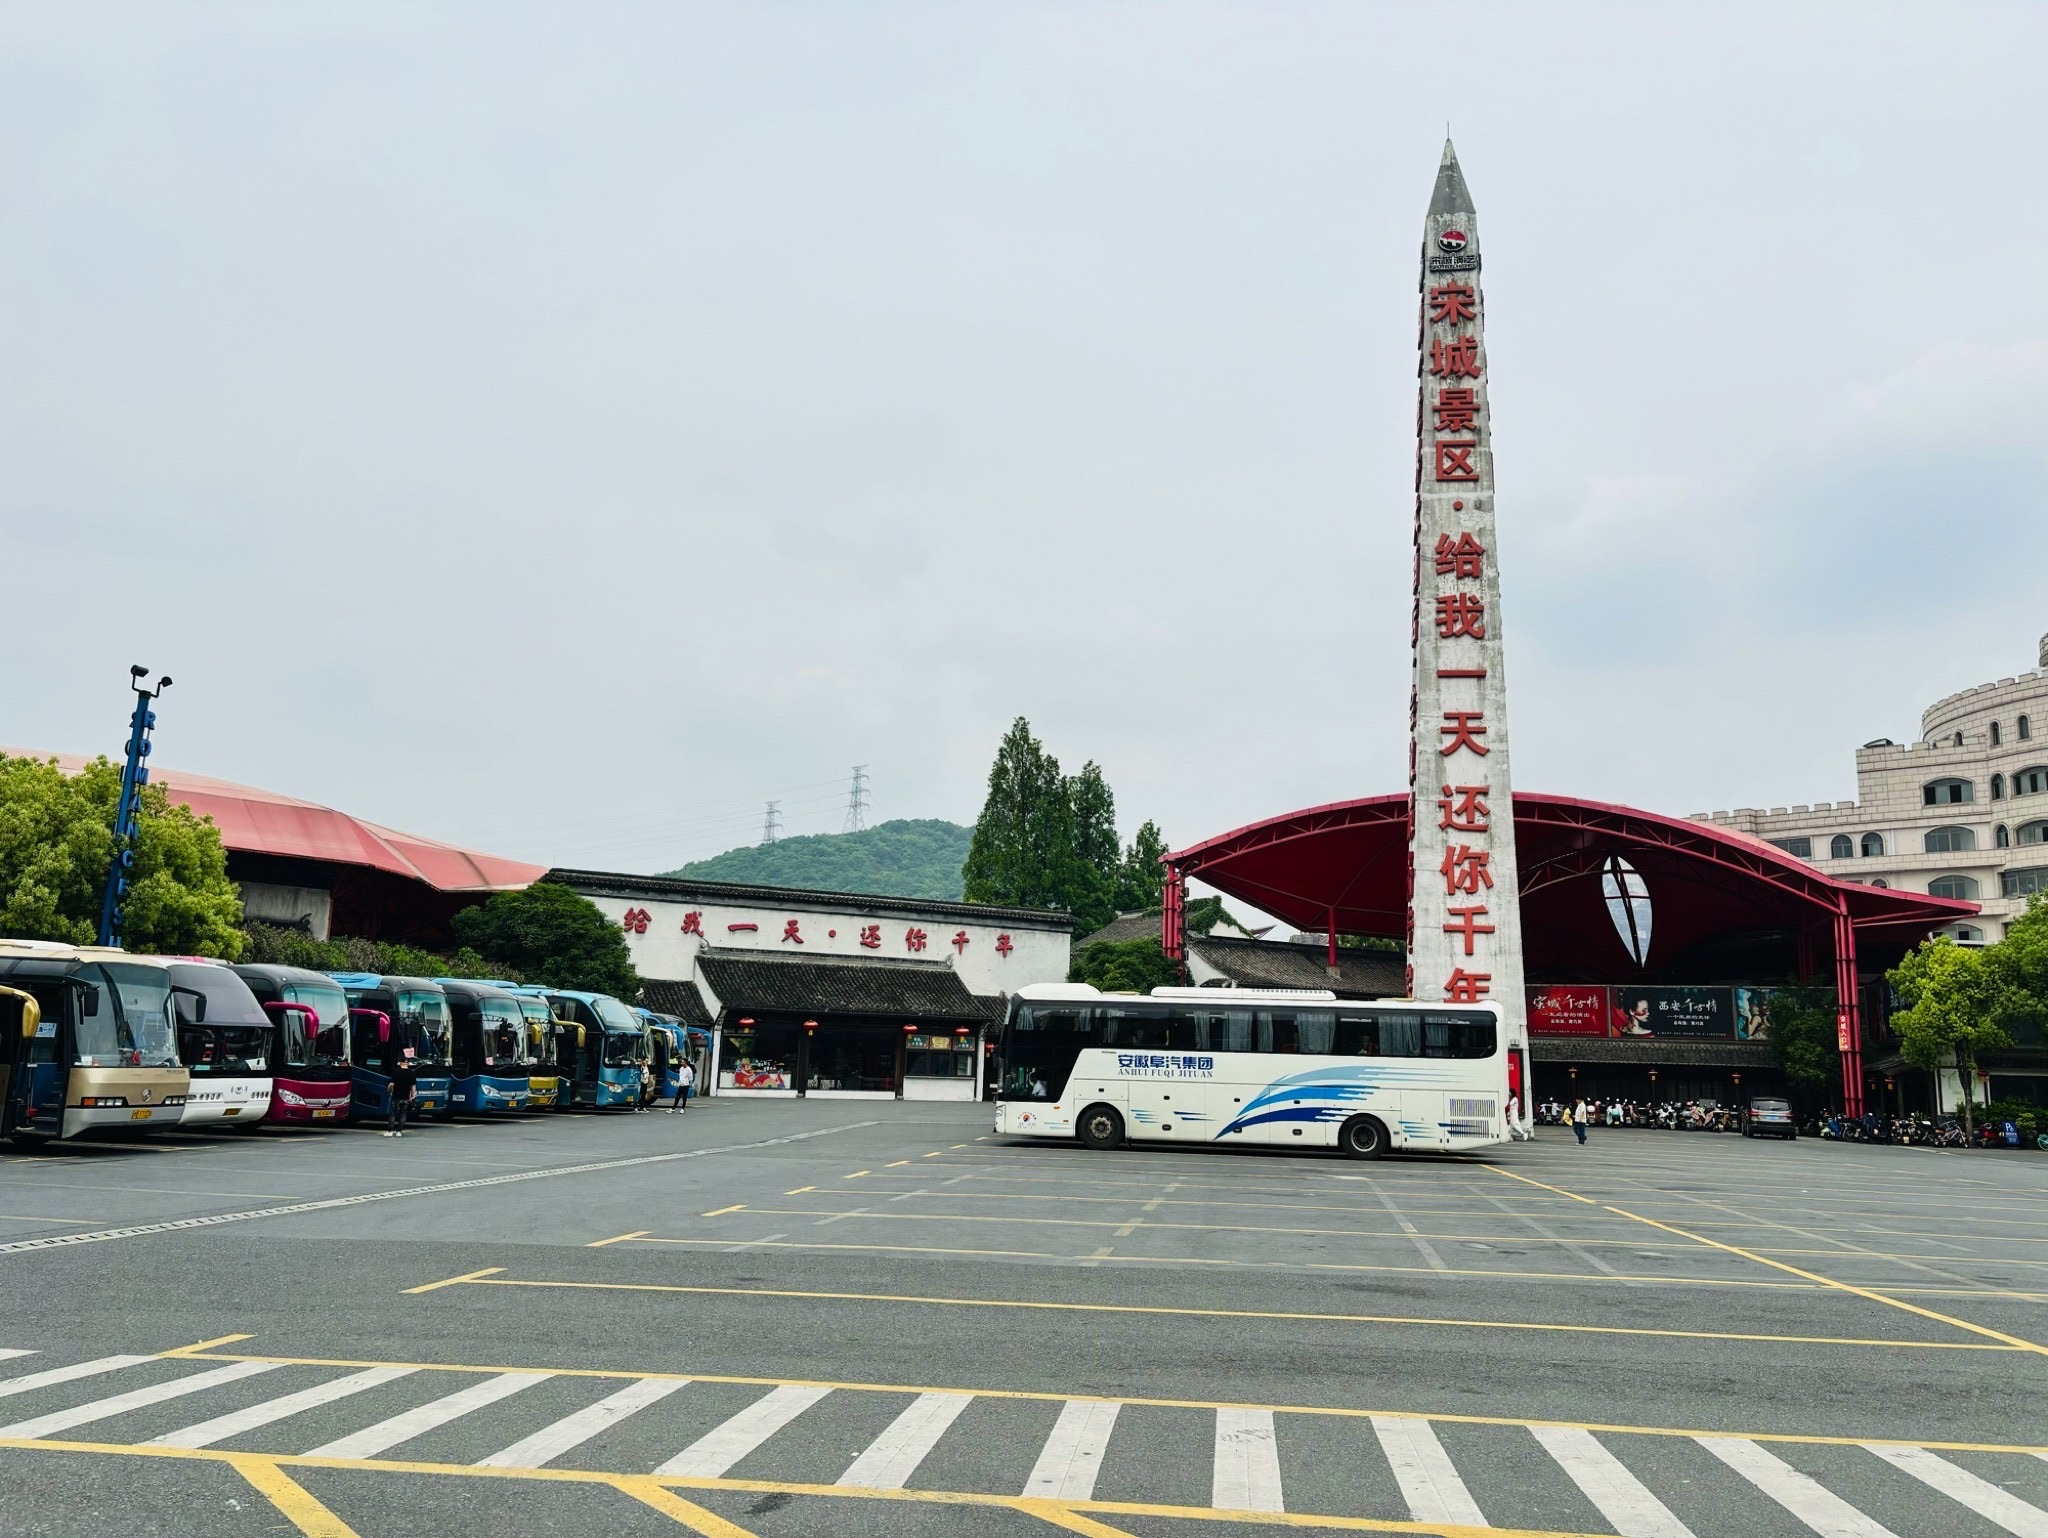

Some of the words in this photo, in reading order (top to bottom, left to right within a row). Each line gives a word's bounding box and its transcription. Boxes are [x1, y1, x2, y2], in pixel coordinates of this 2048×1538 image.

[624, 907, 1013, 958] 给我一天·还你千年
[1533, 994, 1599, 1010] 宋城千古情
[1659, 999, 1717, 1013] 西安千古情
[1118, 1054, 1213, 1070] 安徽阜汽集团
[1118, 1068, 1148, 1076] ANHUI
[1151, 1069, 1174, 1077] FUQI
[1178, 1070, 1213, 1078] JITUAN
